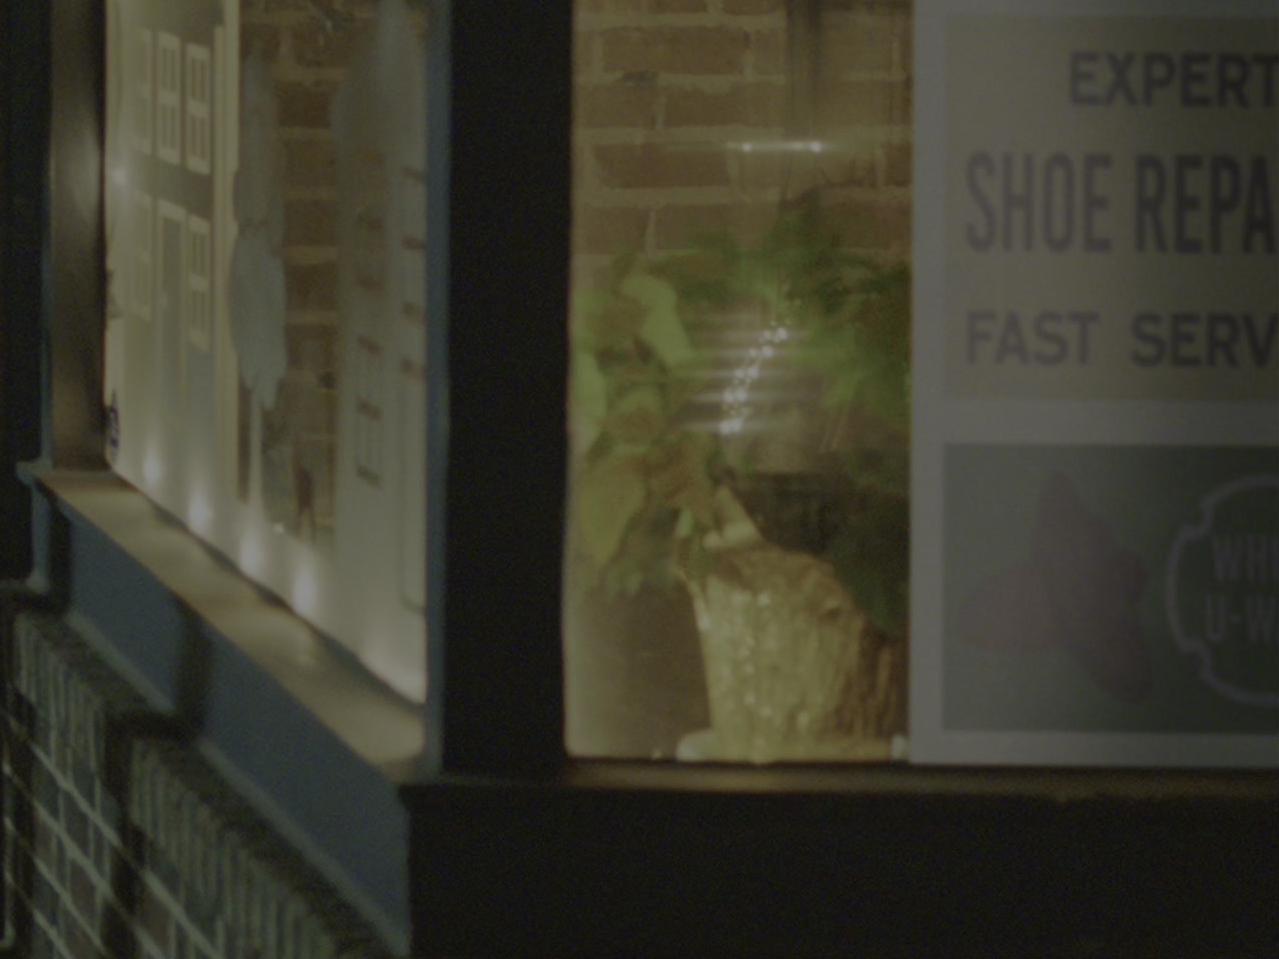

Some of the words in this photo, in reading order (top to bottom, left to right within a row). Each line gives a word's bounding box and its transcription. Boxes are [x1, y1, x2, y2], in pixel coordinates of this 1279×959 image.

[1068, 51, 1279, 108] EXPERT
[965, 151, 1113, 253] SHOE
[1134, 152, 1277, 255] REPA
[965, 309, 1100, 367] FAST
[1129, 311, 1279, 369] SERV
